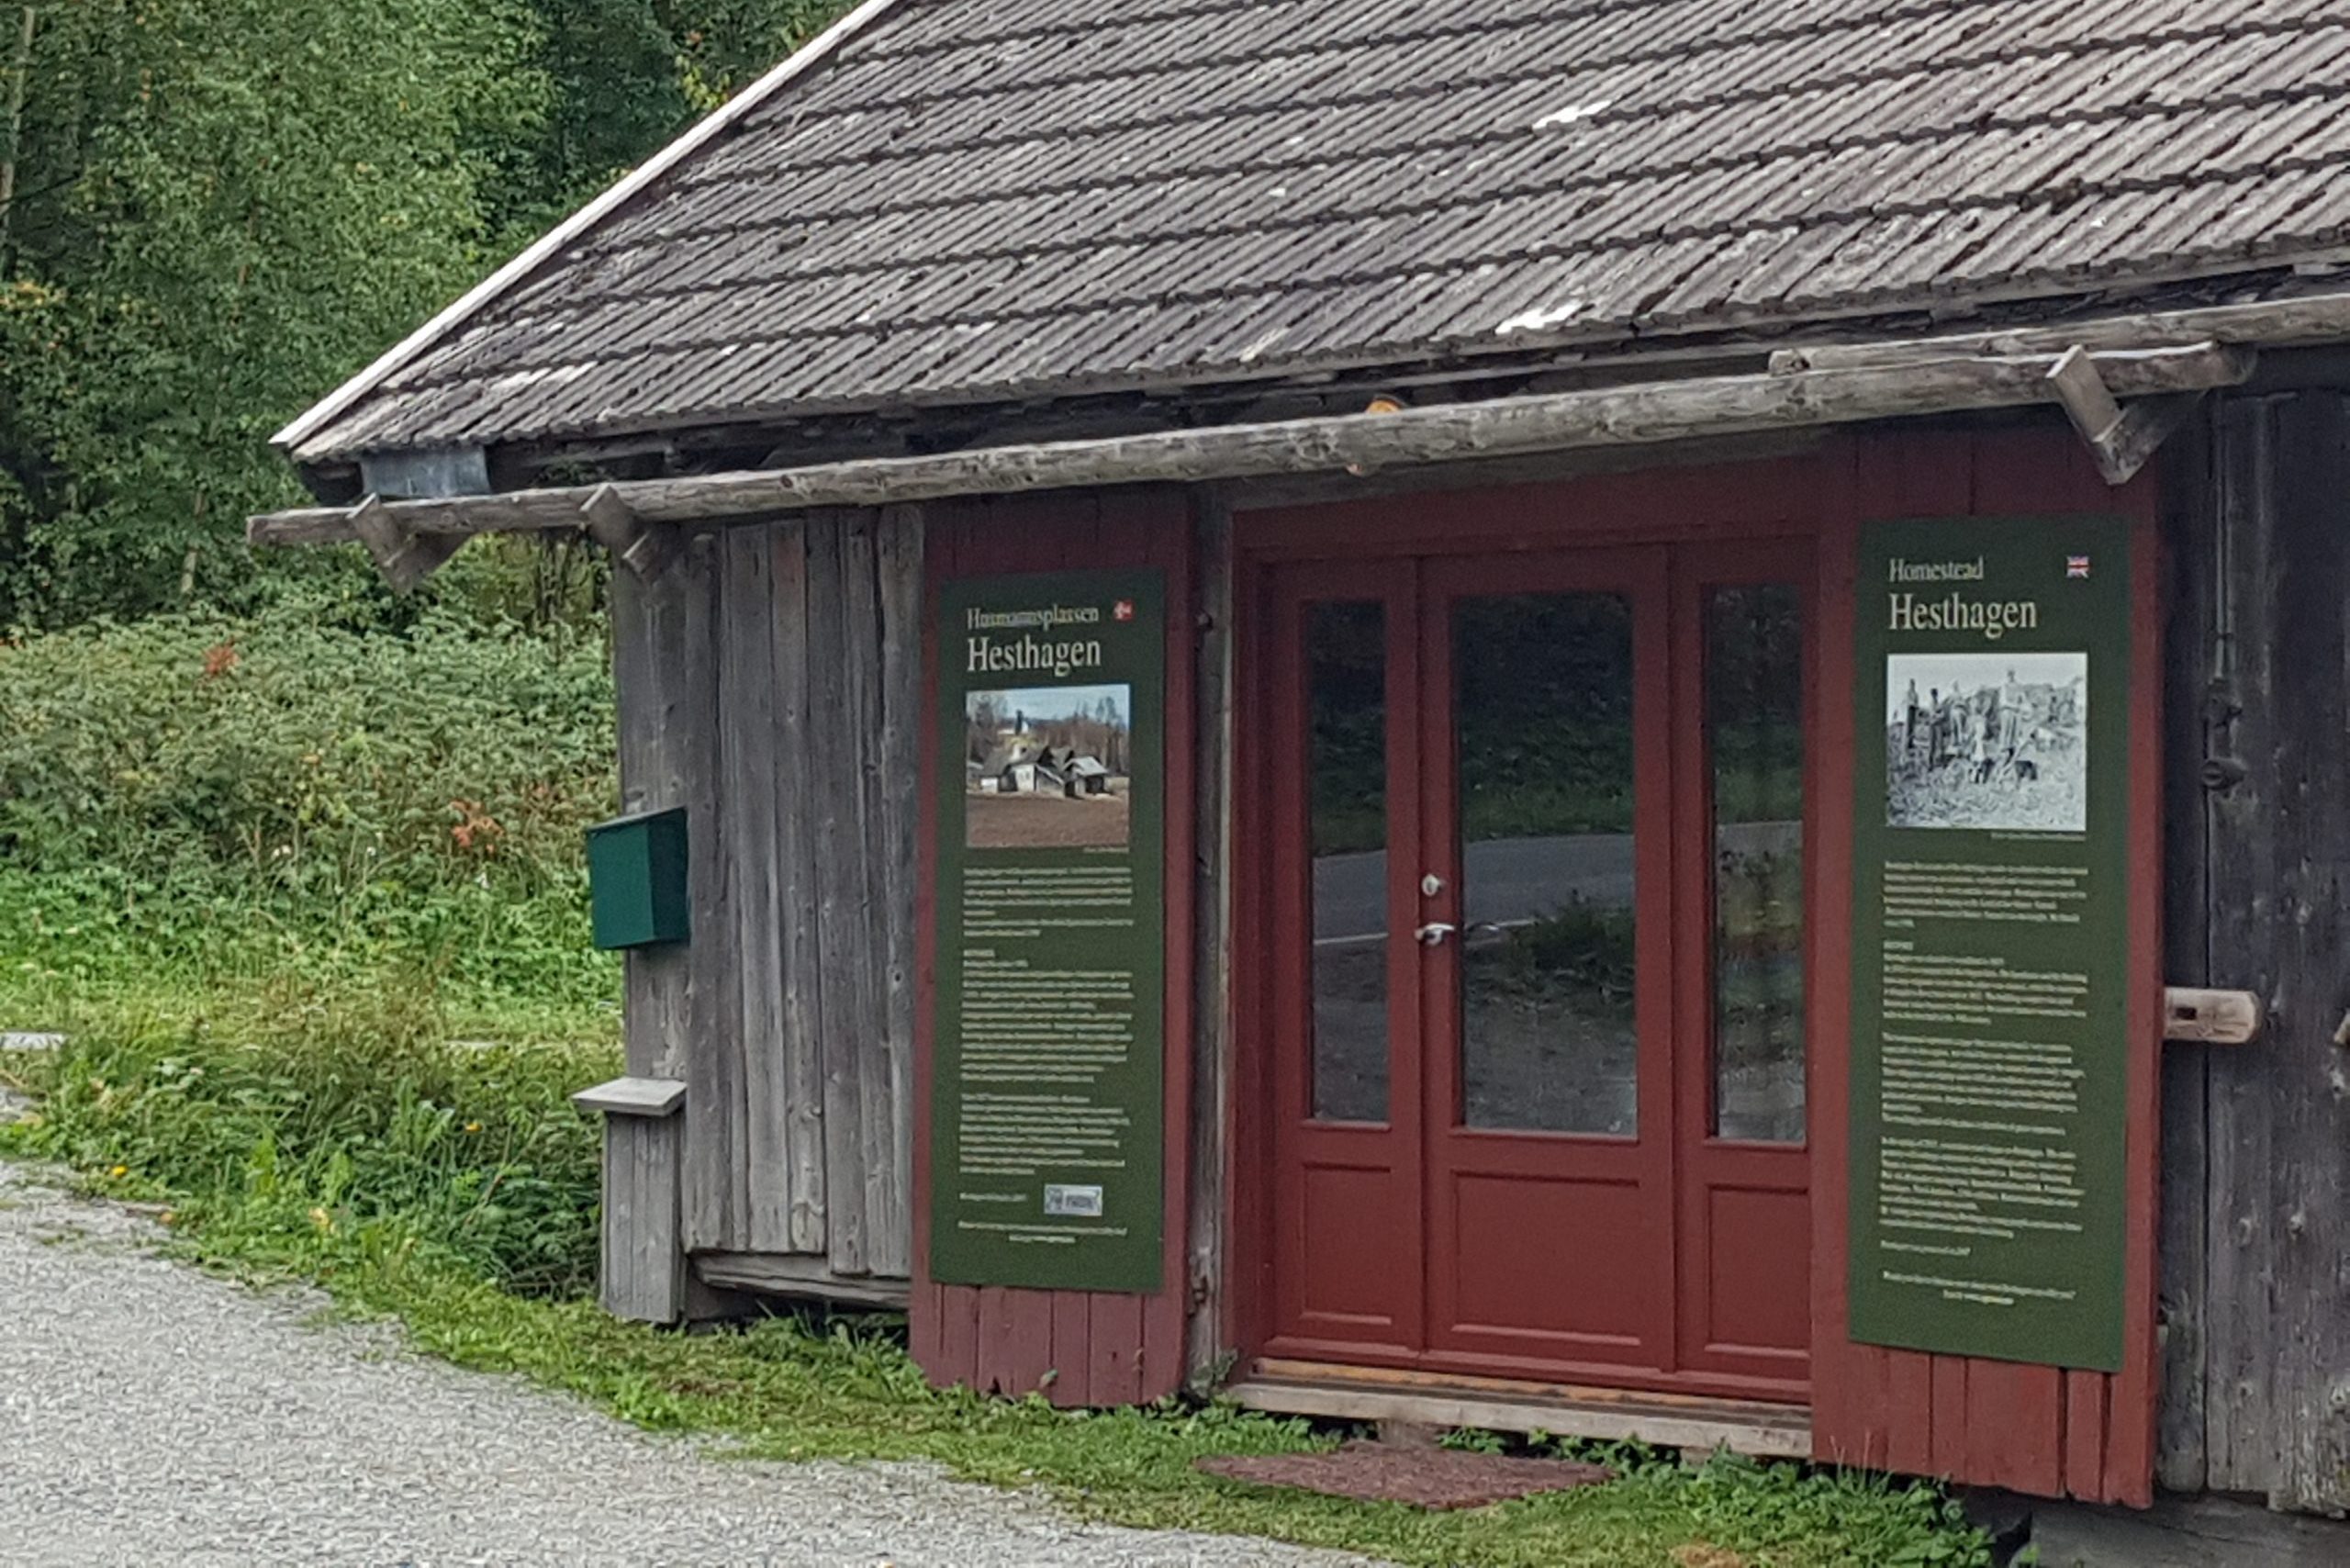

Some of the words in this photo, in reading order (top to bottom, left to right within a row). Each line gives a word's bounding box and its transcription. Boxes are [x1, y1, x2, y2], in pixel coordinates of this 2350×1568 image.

[1889, 555, 1984, 582] Homestead
[1888, 592, 2037, 639] Hesthagen
[967, 633, 1101, 677] Hesthagen
